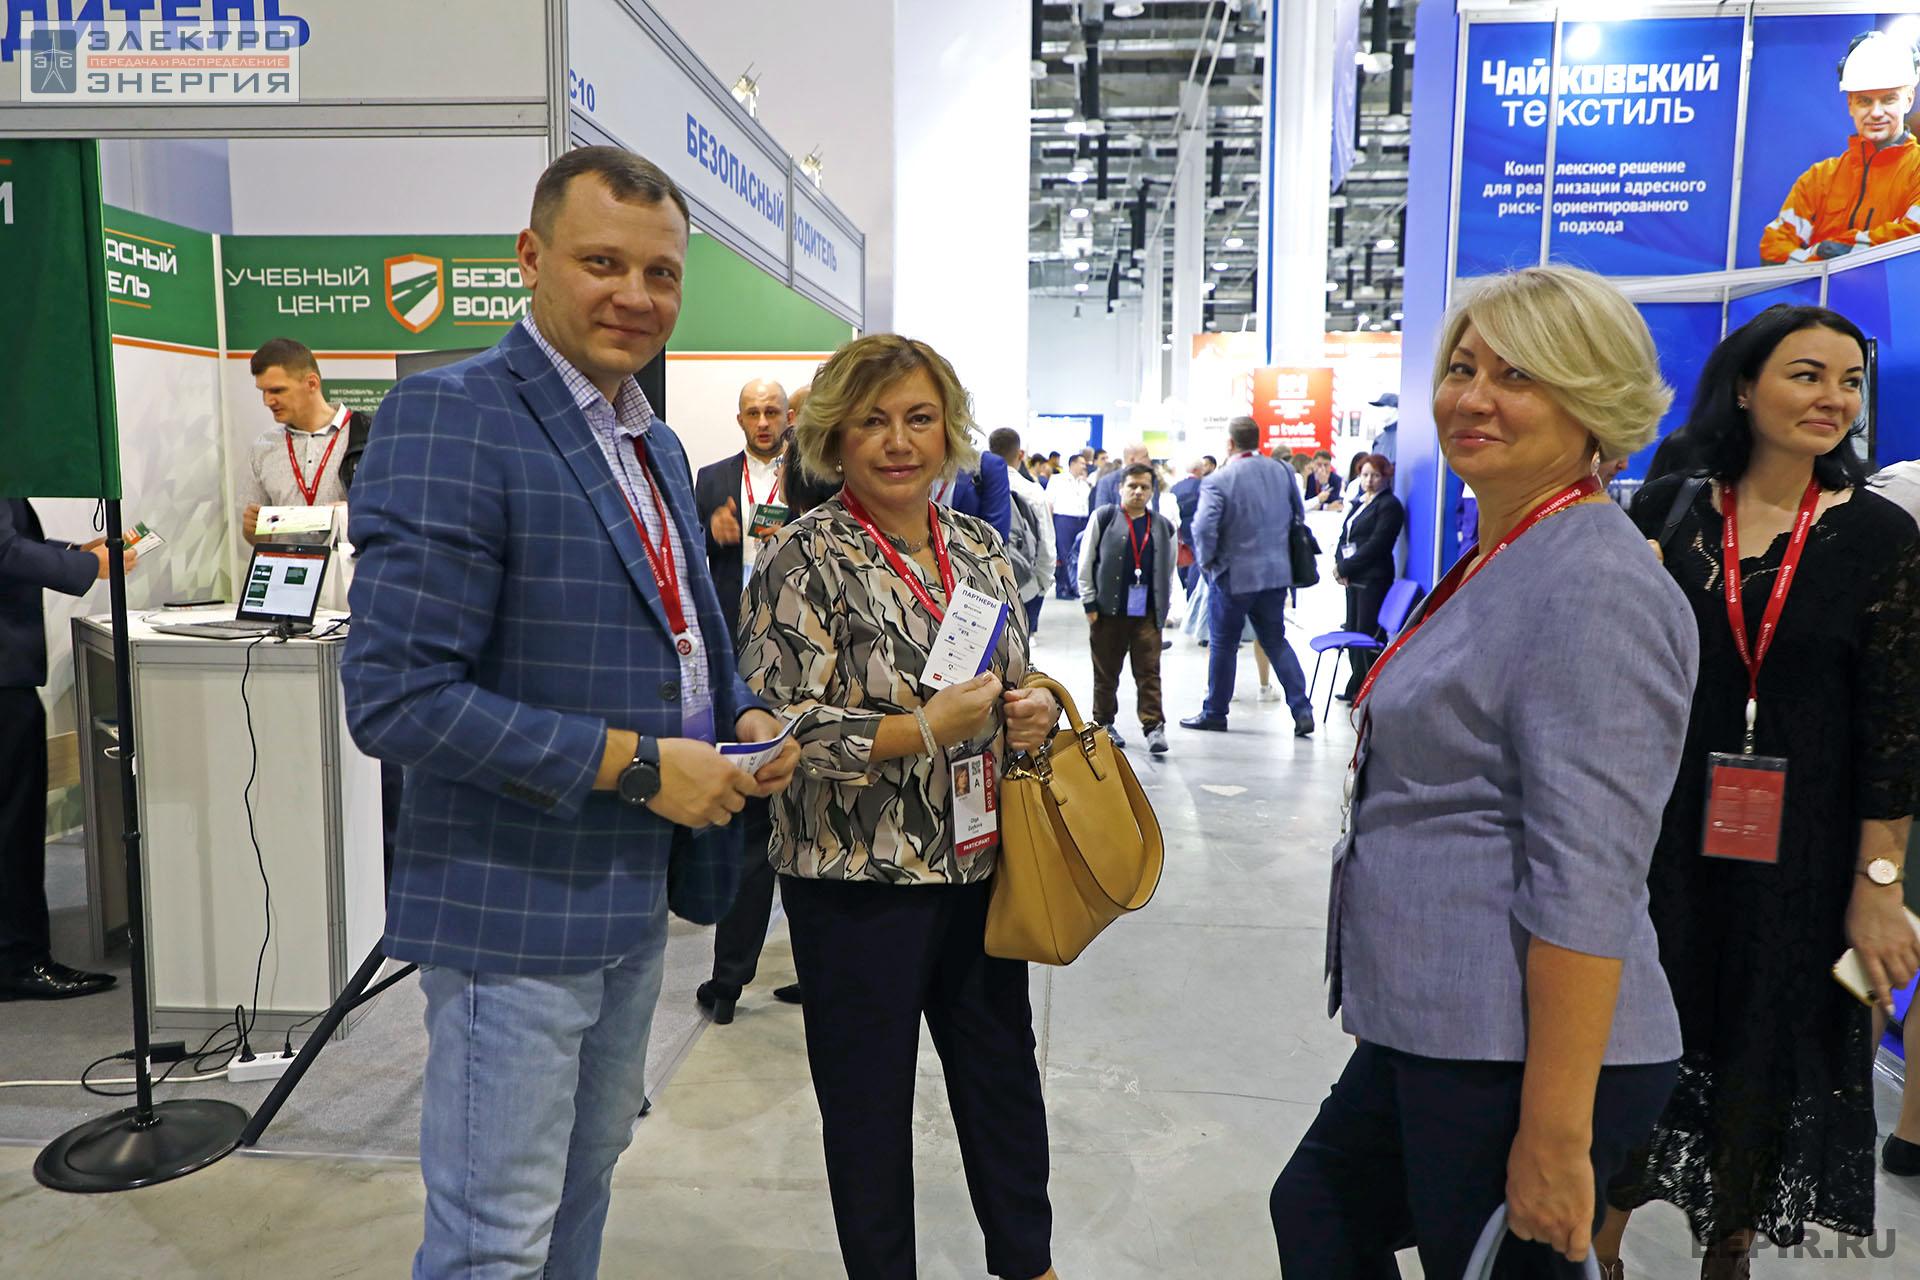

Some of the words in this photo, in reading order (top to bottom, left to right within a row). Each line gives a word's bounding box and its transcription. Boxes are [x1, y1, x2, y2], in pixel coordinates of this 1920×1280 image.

[1501, 98, 1695, 127] текстиль
[687, 112, 784, 232] БЕЗОПАСНЫЙ
[1619, 161, 1686, 177] решение
[1483, 183, 1511, 197] для
[1624, 180, 1706, 196] адресного
[1559, 219, 1624, 234] подхода
[226, 265, 370, 287] УЧЕБНЫЙ
[278, 295, 370, 317] ЦЕНТР
[453, 296, 532, 320] ВОДИ
[962, 589, 997, 609] ПАРТНЕРЫ
[963, 837, 990, 851] PARTICIPANT
